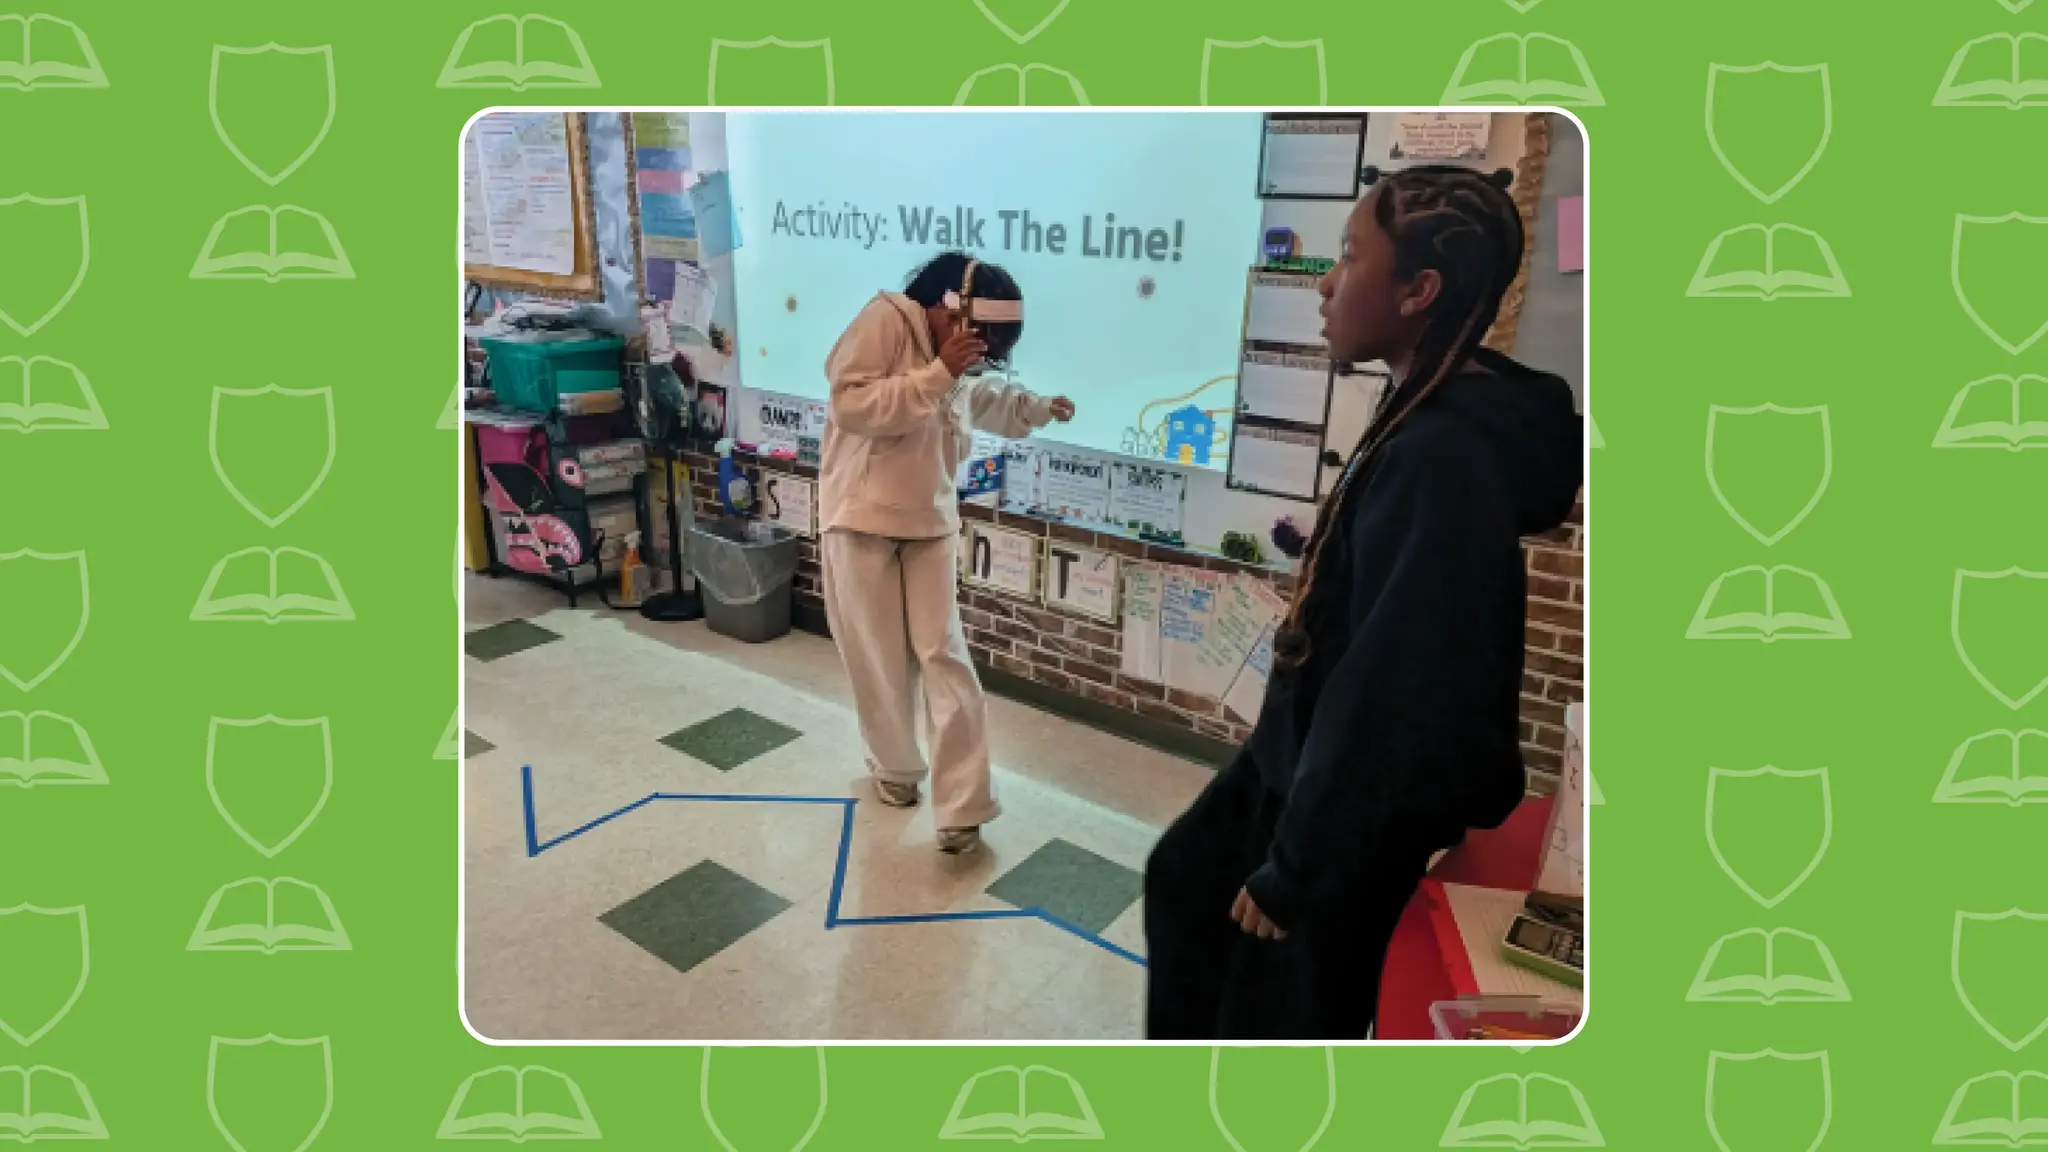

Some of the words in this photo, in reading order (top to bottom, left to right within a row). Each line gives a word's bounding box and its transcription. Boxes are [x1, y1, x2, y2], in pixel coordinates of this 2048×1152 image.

[772, 199, 888, 250] Activity:
[898, 204, 986, 248] Walk
[997, 208, 1067, 254] The
[1081, 212, 1184, 262] Line!
[767, 478, 781, 520] S
[1051, 548, 1081, 599] T
